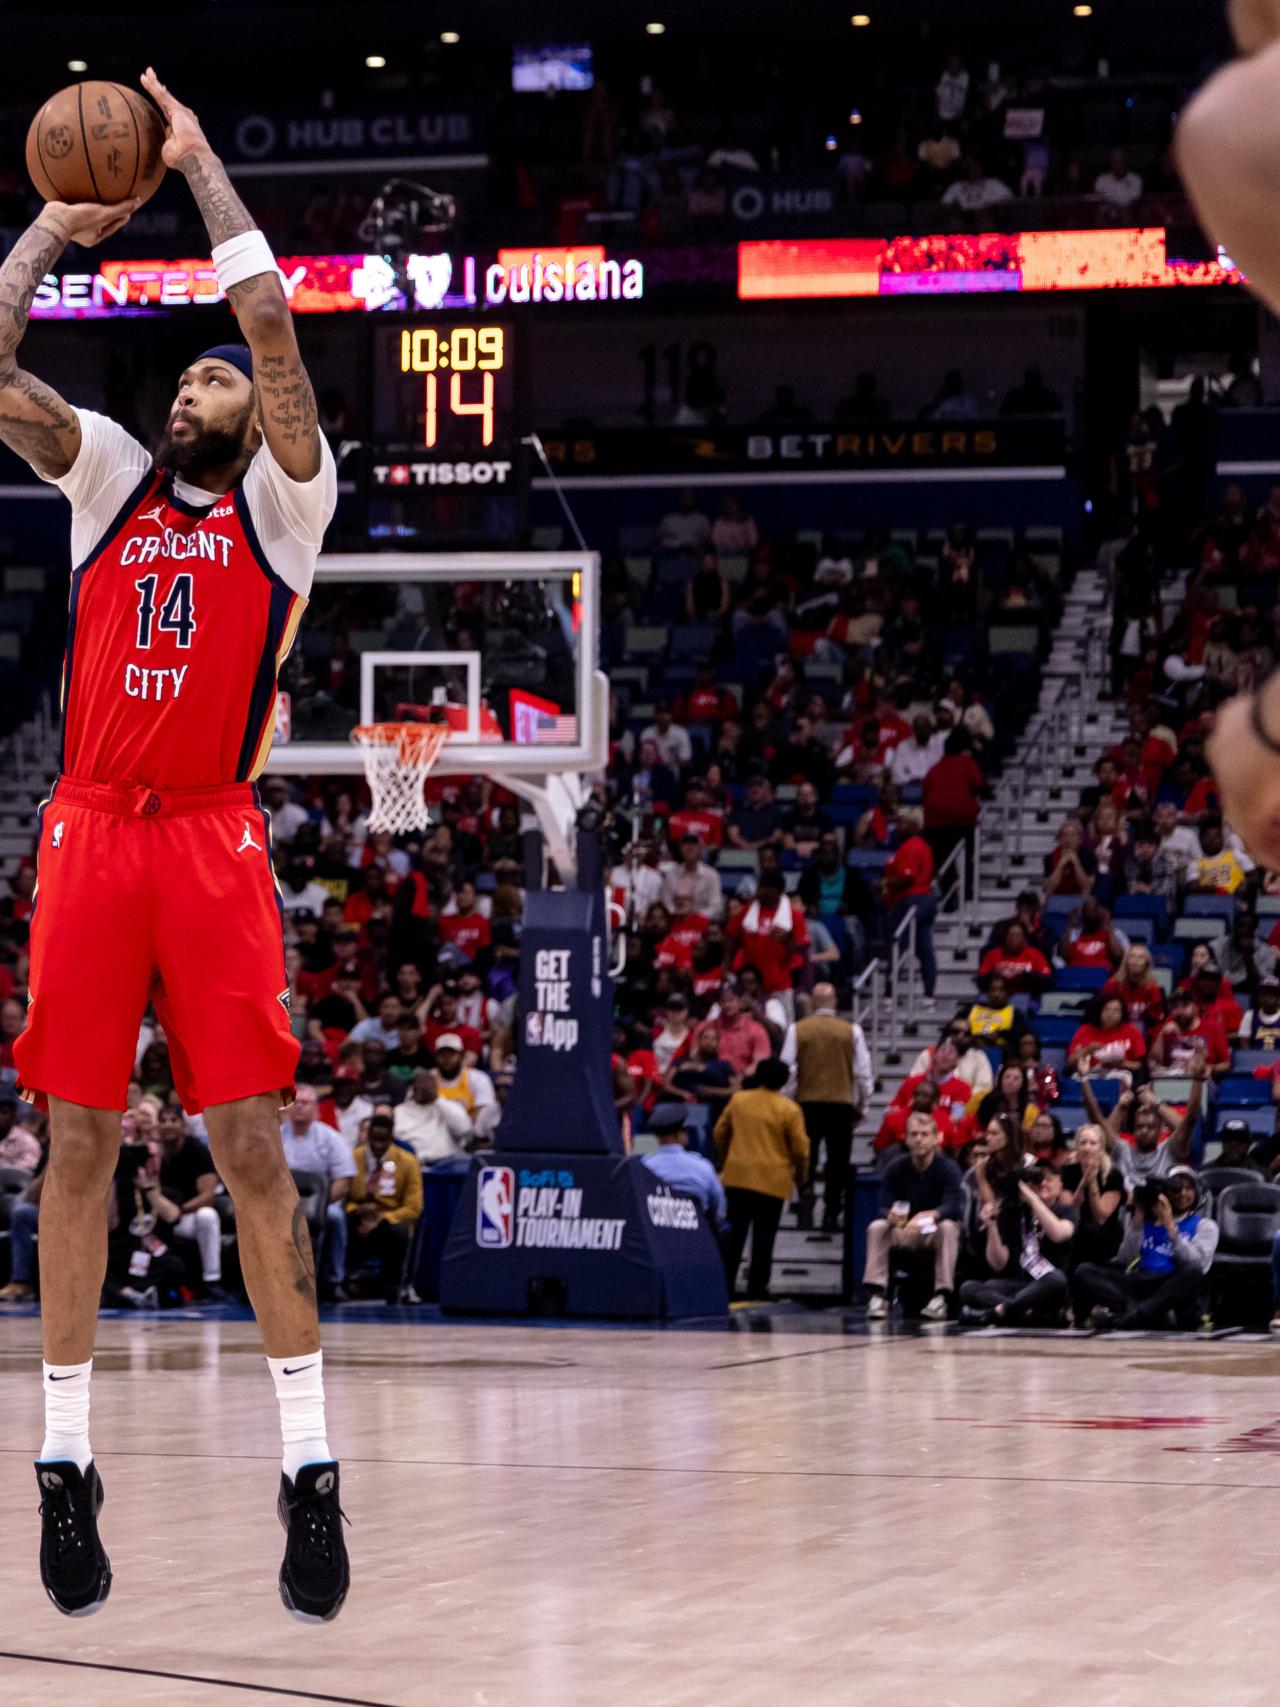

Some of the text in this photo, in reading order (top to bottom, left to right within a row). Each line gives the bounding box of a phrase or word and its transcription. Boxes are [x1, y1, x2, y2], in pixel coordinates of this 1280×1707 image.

[286, 113, 471, 149] HUB CLUB
[771, 189, 832, 215] HUB
[401, 327, 504, 372] 10:09
[425, 371, 494, 447] 14
[746, 431, 1000, 461] BETRIVERS
[410, 462, 511, 485] TISSOT
[120, 527, 234, 568] CRSCENT
[135, 573, 196, 649] 14
[124, 663, 188, 700] CITY
[535, 949, 571, 980] GET
[534, 981, 571, 1012] THE
[542, 1012, 578, 1051] App
[517, 1187, 583, 1218] PLAY-IN
[515, 1217, 627, 1250] TOURNAMENT
